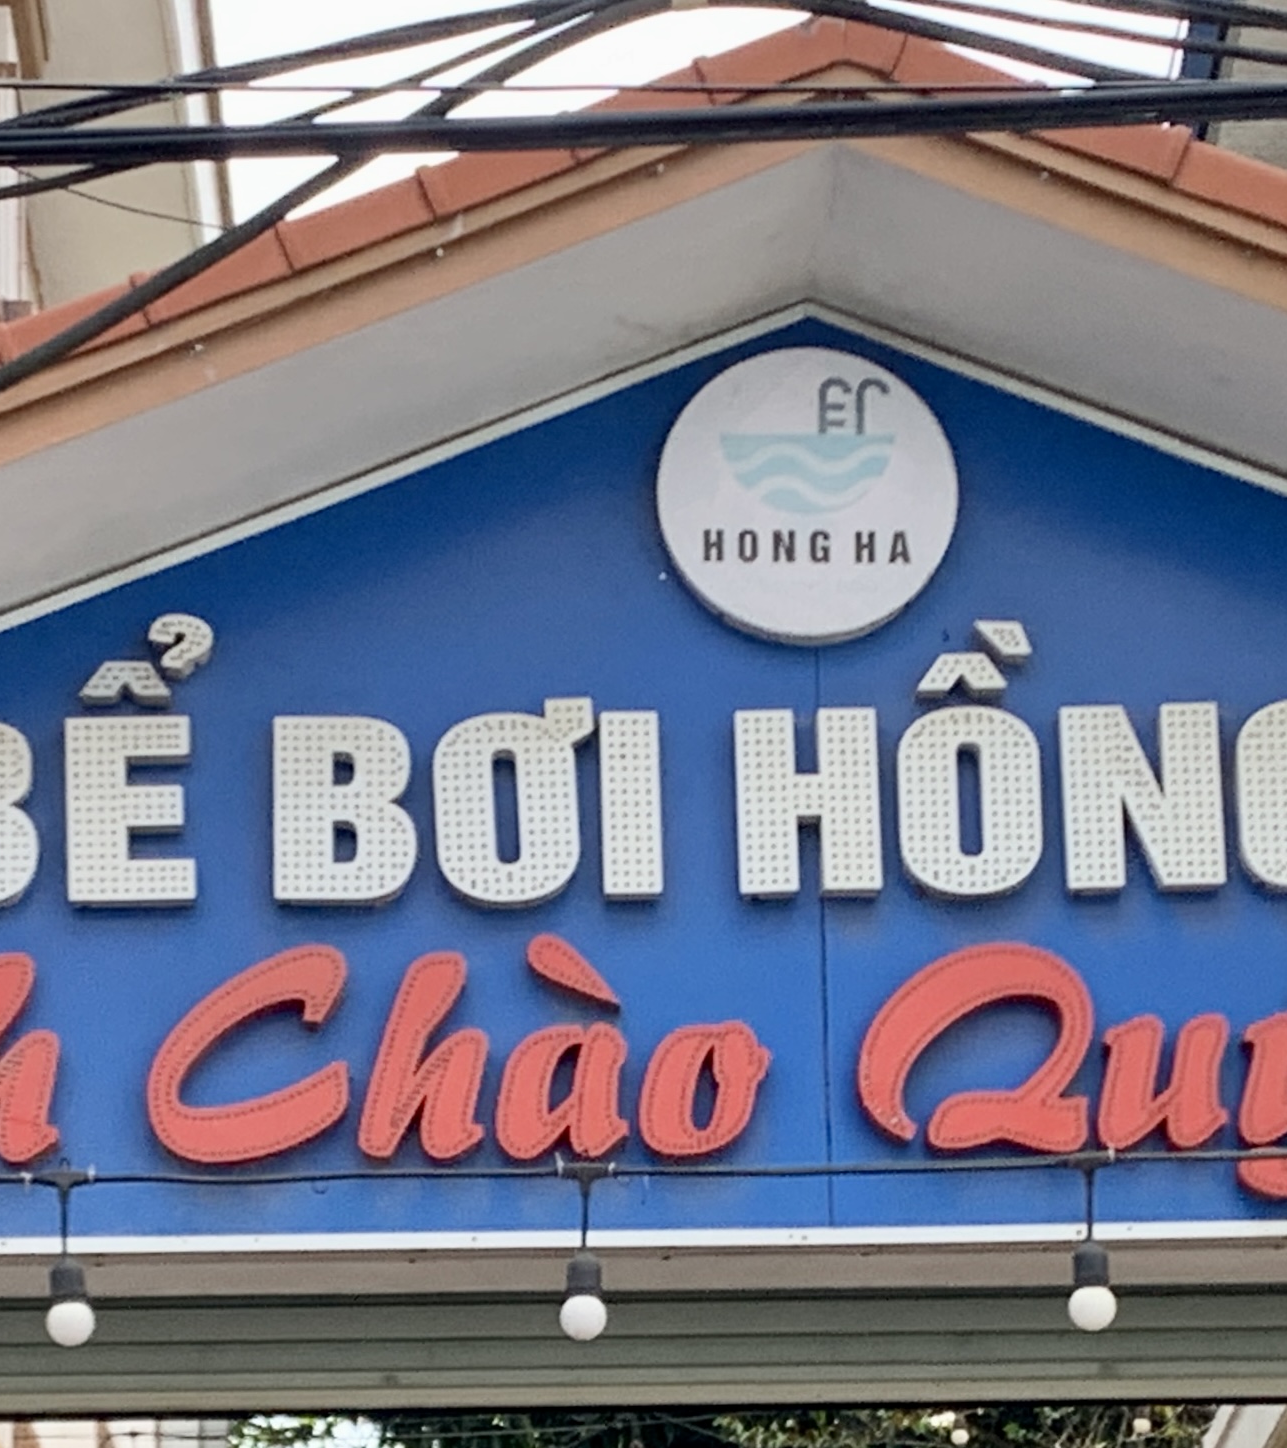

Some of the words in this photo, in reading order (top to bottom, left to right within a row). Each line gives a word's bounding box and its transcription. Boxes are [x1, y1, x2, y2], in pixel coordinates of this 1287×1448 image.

[703, 528, 831, 563] HONG
[854, 530, 912, 564] HA
[272, 696, 665, 908] BƠI
[146, 933, 772, 1165] Chào
